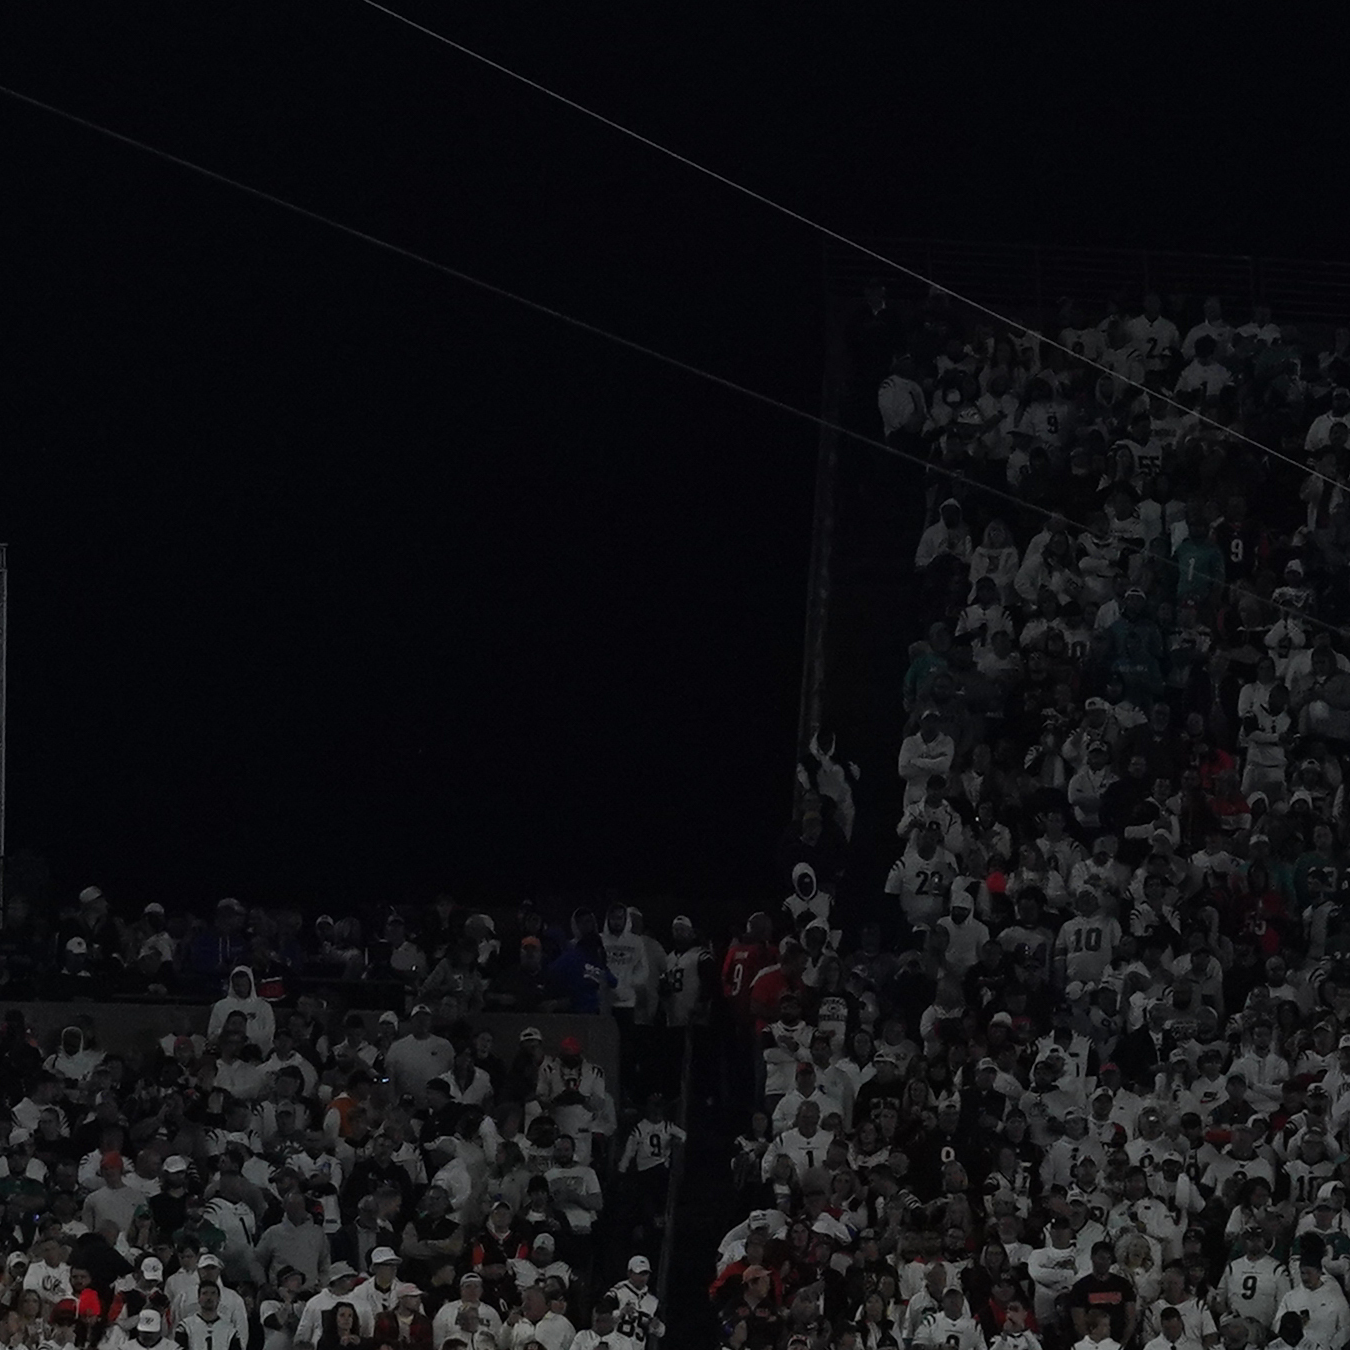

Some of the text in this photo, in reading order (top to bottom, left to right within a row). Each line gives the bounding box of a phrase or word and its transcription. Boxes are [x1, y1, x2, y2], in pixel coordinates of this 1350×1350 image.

[1231, 539, 1244, 562] 9
[1073, 927, 1102, 952] 10
[731, 965, 743, 996] 9
[649, 1134, 661, 1157] 9
[806, 1150, 814, 1168] 1
[1243, 1275, 1257, 1300] 9
